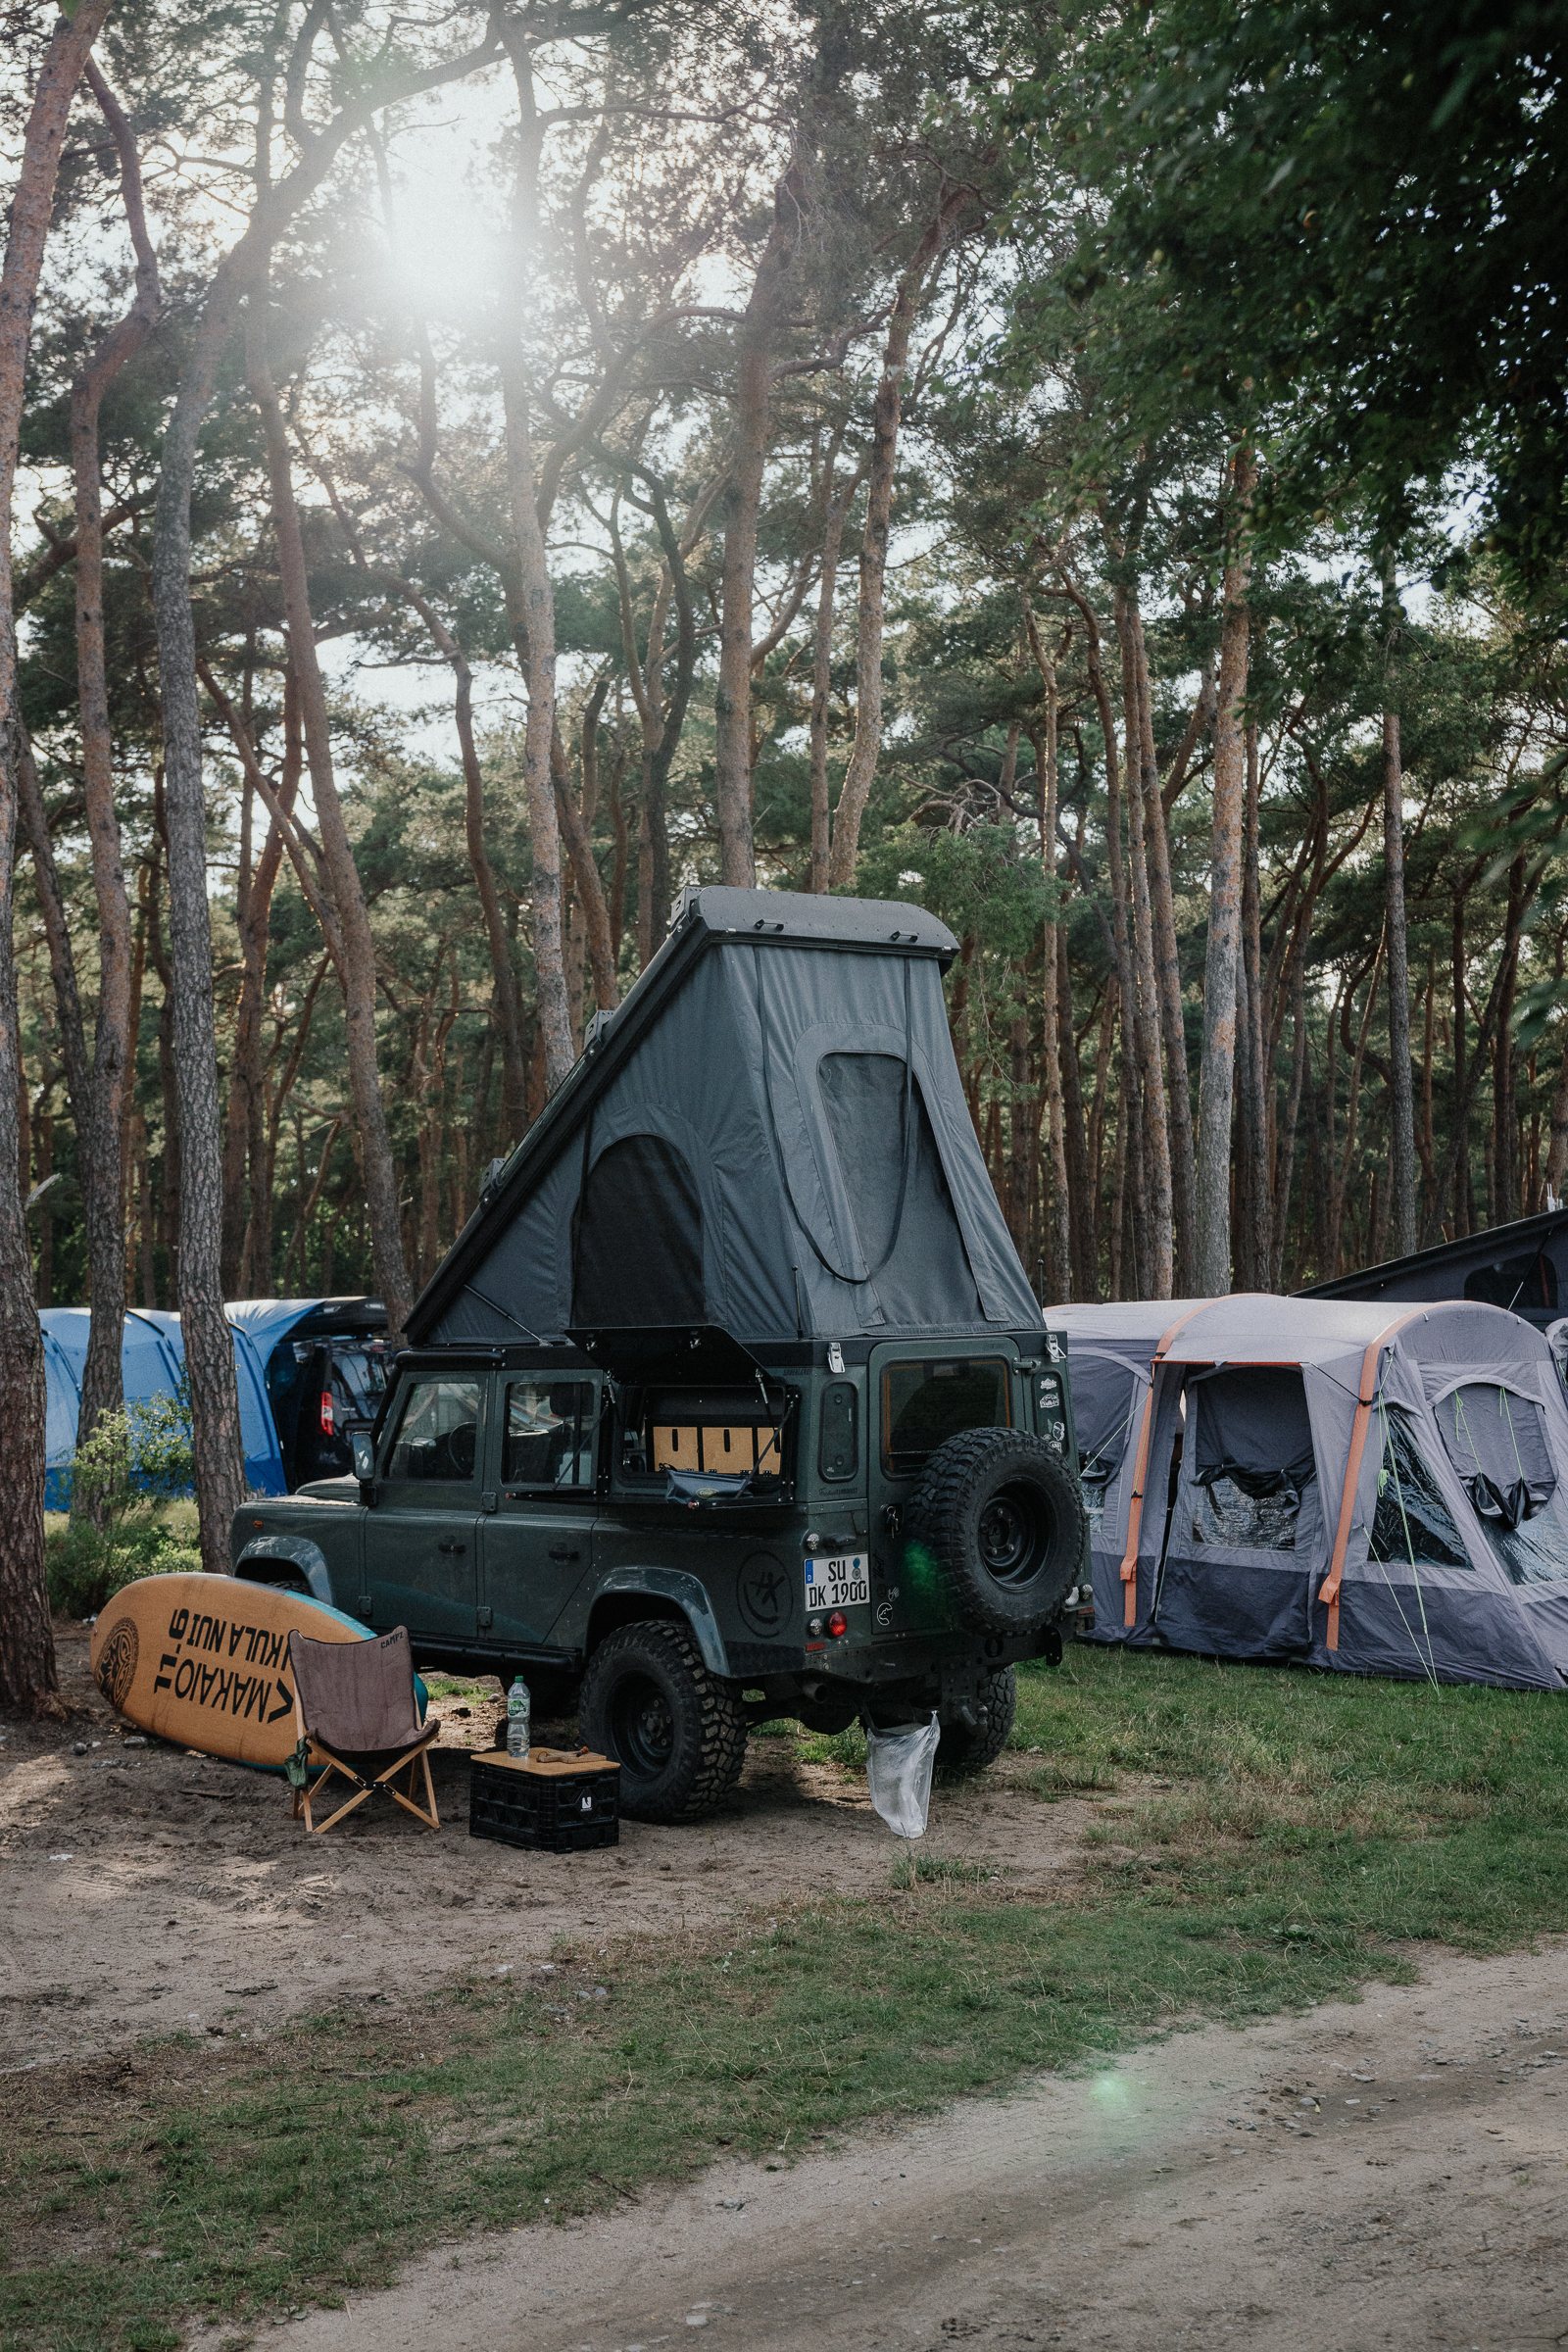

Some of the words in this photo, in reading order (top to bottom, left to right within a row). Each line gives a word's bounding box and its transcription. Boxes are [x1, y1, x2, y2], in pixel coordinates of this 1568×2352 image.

[828, 1560, 846, 1582] SU
[808, 1585, 826, 1607] DK
[831, 1580, 867, 1604] 1900
[186, 1613, 227, 1653] NUI
[228, 1623, 285, 1668] KULA
[380, 1631, 404, 1649] CAMPZ
[175, 1659, 272, 1723] MAKAIO
